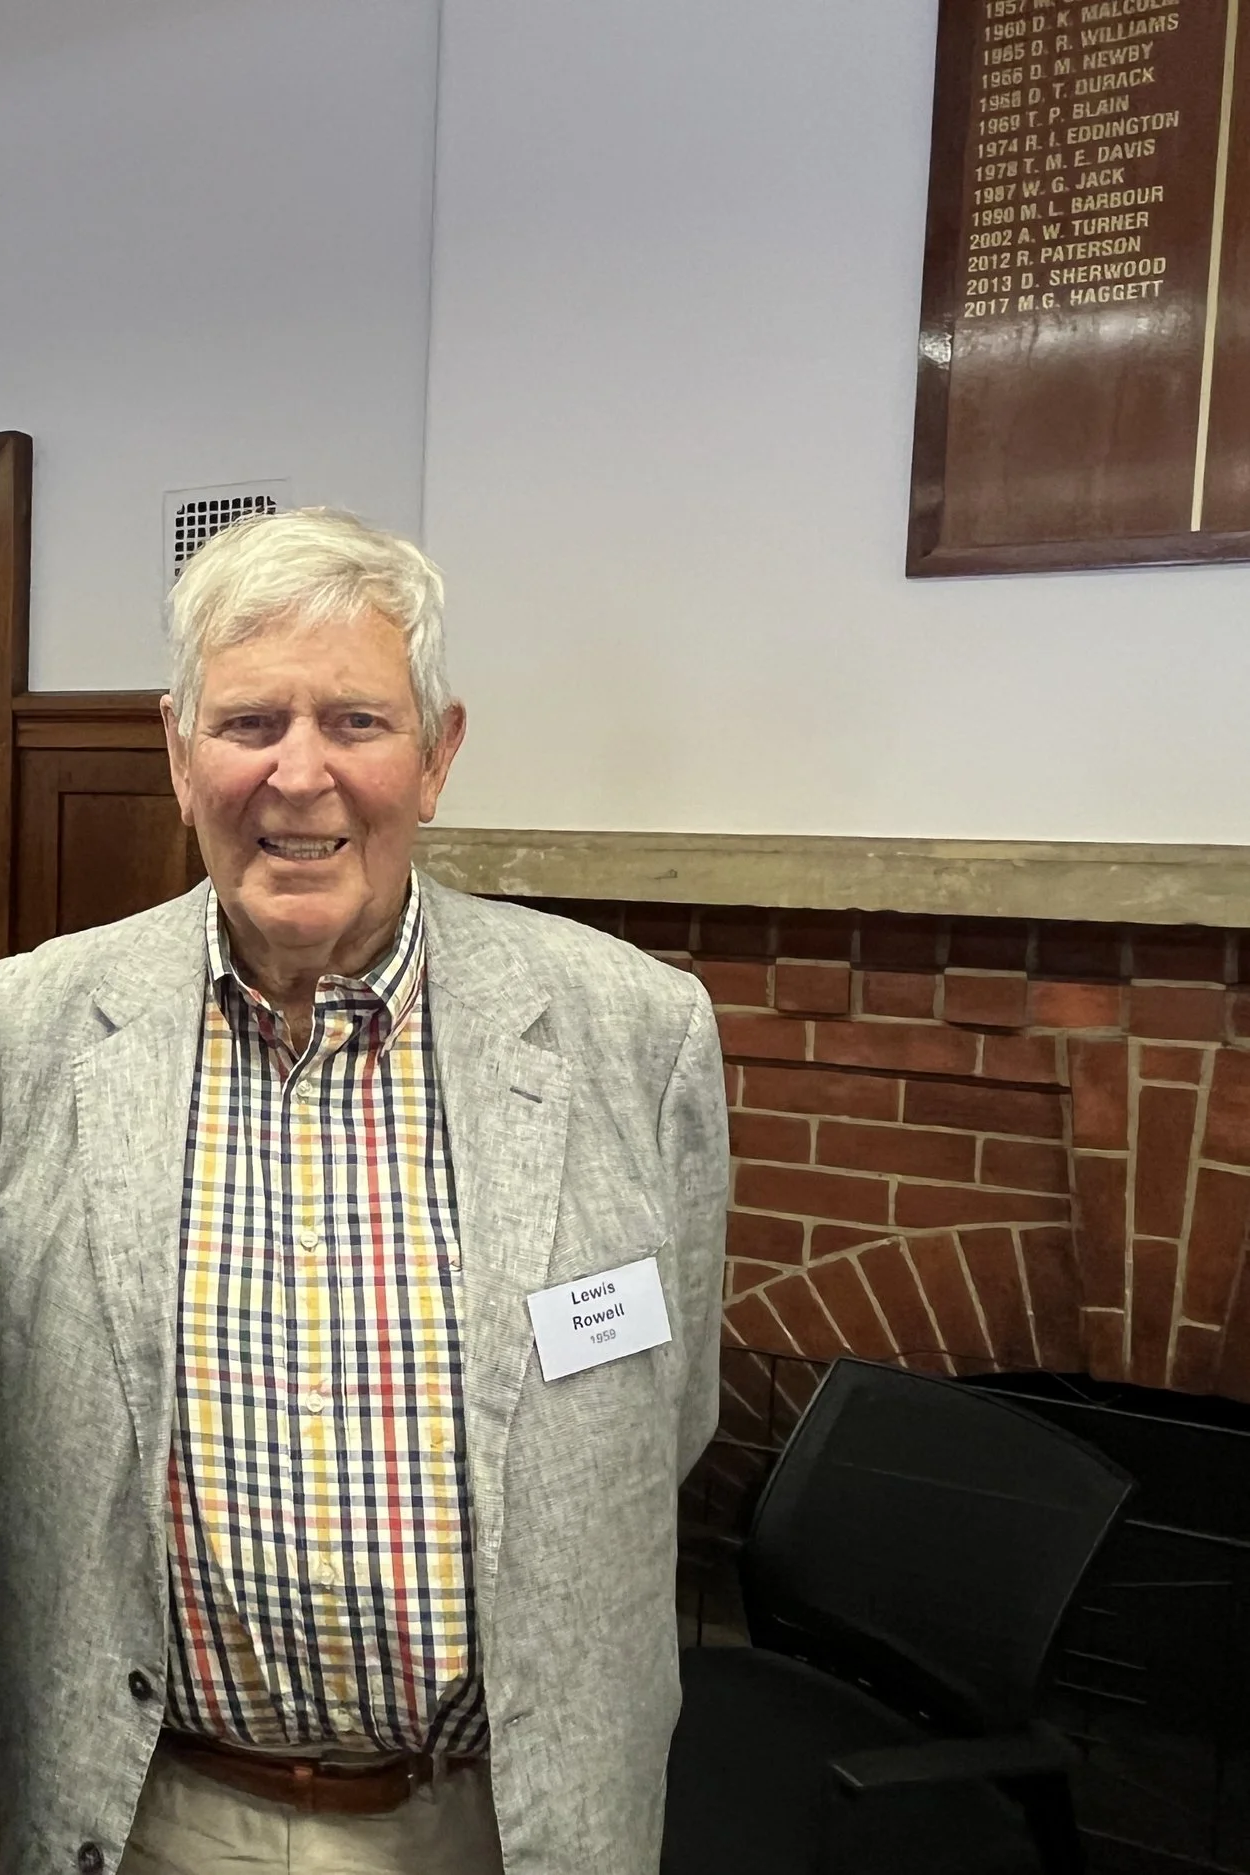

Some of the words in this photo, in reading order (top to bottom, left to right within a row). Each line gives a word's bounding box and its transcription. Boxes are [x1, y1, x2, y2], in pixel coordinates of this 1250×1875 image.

[985, 20, 1026, 42] 1960
[1033, 16, 1051, 32] D.
[1056, 35, 1073, 52] R.
[1081, 13, 1179, 48] WILLIAMS
[1054, 58, 1076, 76] M.
[1083, 41, 1154, 70] NEWBY
[1053, 83, 1067, 99] T.
[1075, 67, 1155, 95] DURACK
[979, 115, 1020, 136] 1969
[1026, 111, 1042, 127] T.
[1049, 107, 1065, 125] P.
[1072, 95, 1129, 119] BLAIN
[979, 138, 1018, 158] 1974
[1026, 135, 1042, 151] R.
[1049, 131, 1060, 147] I.
[1067, 111, 1179, 144] EDDINGTON
[1024, 158, 1039, 174] T.
[1046, 154, 1067, 171] M.
[1098, 139, 1156, 163] DAVIS
[1023, 180, 1046, 197] W.
[1052, 177, 1070, 193] G.
[1075, 168, 1125, 190] JACK
[1021, 204, 1042, 221] M.
[1049, 201, 1064, 216] L.
[1071, 186, 1164, 214] BARBOUR
[1018, 228, 1036, 244] A.
[1043, 223, 1065, 240] W.
[1072, 212, 1149, 236] TURNER
[968, 253, 1010, 272] 2012
[1017, 250, 1034, 266] R.
[1041, 236, 1140, 263] PATERSON
[967, 276, 1012, 296] 2013
[1021, 273, 1039, 289] D.
[1050, 258, 1166, 286] SHERWOOD
[964, 298, 1009, 318] 2017
[1070, 280, 1164, 306] HAGGETT
[571, 1282, 615, 1305] Lewis
[572, 1303, 625, 1330] Rowell
